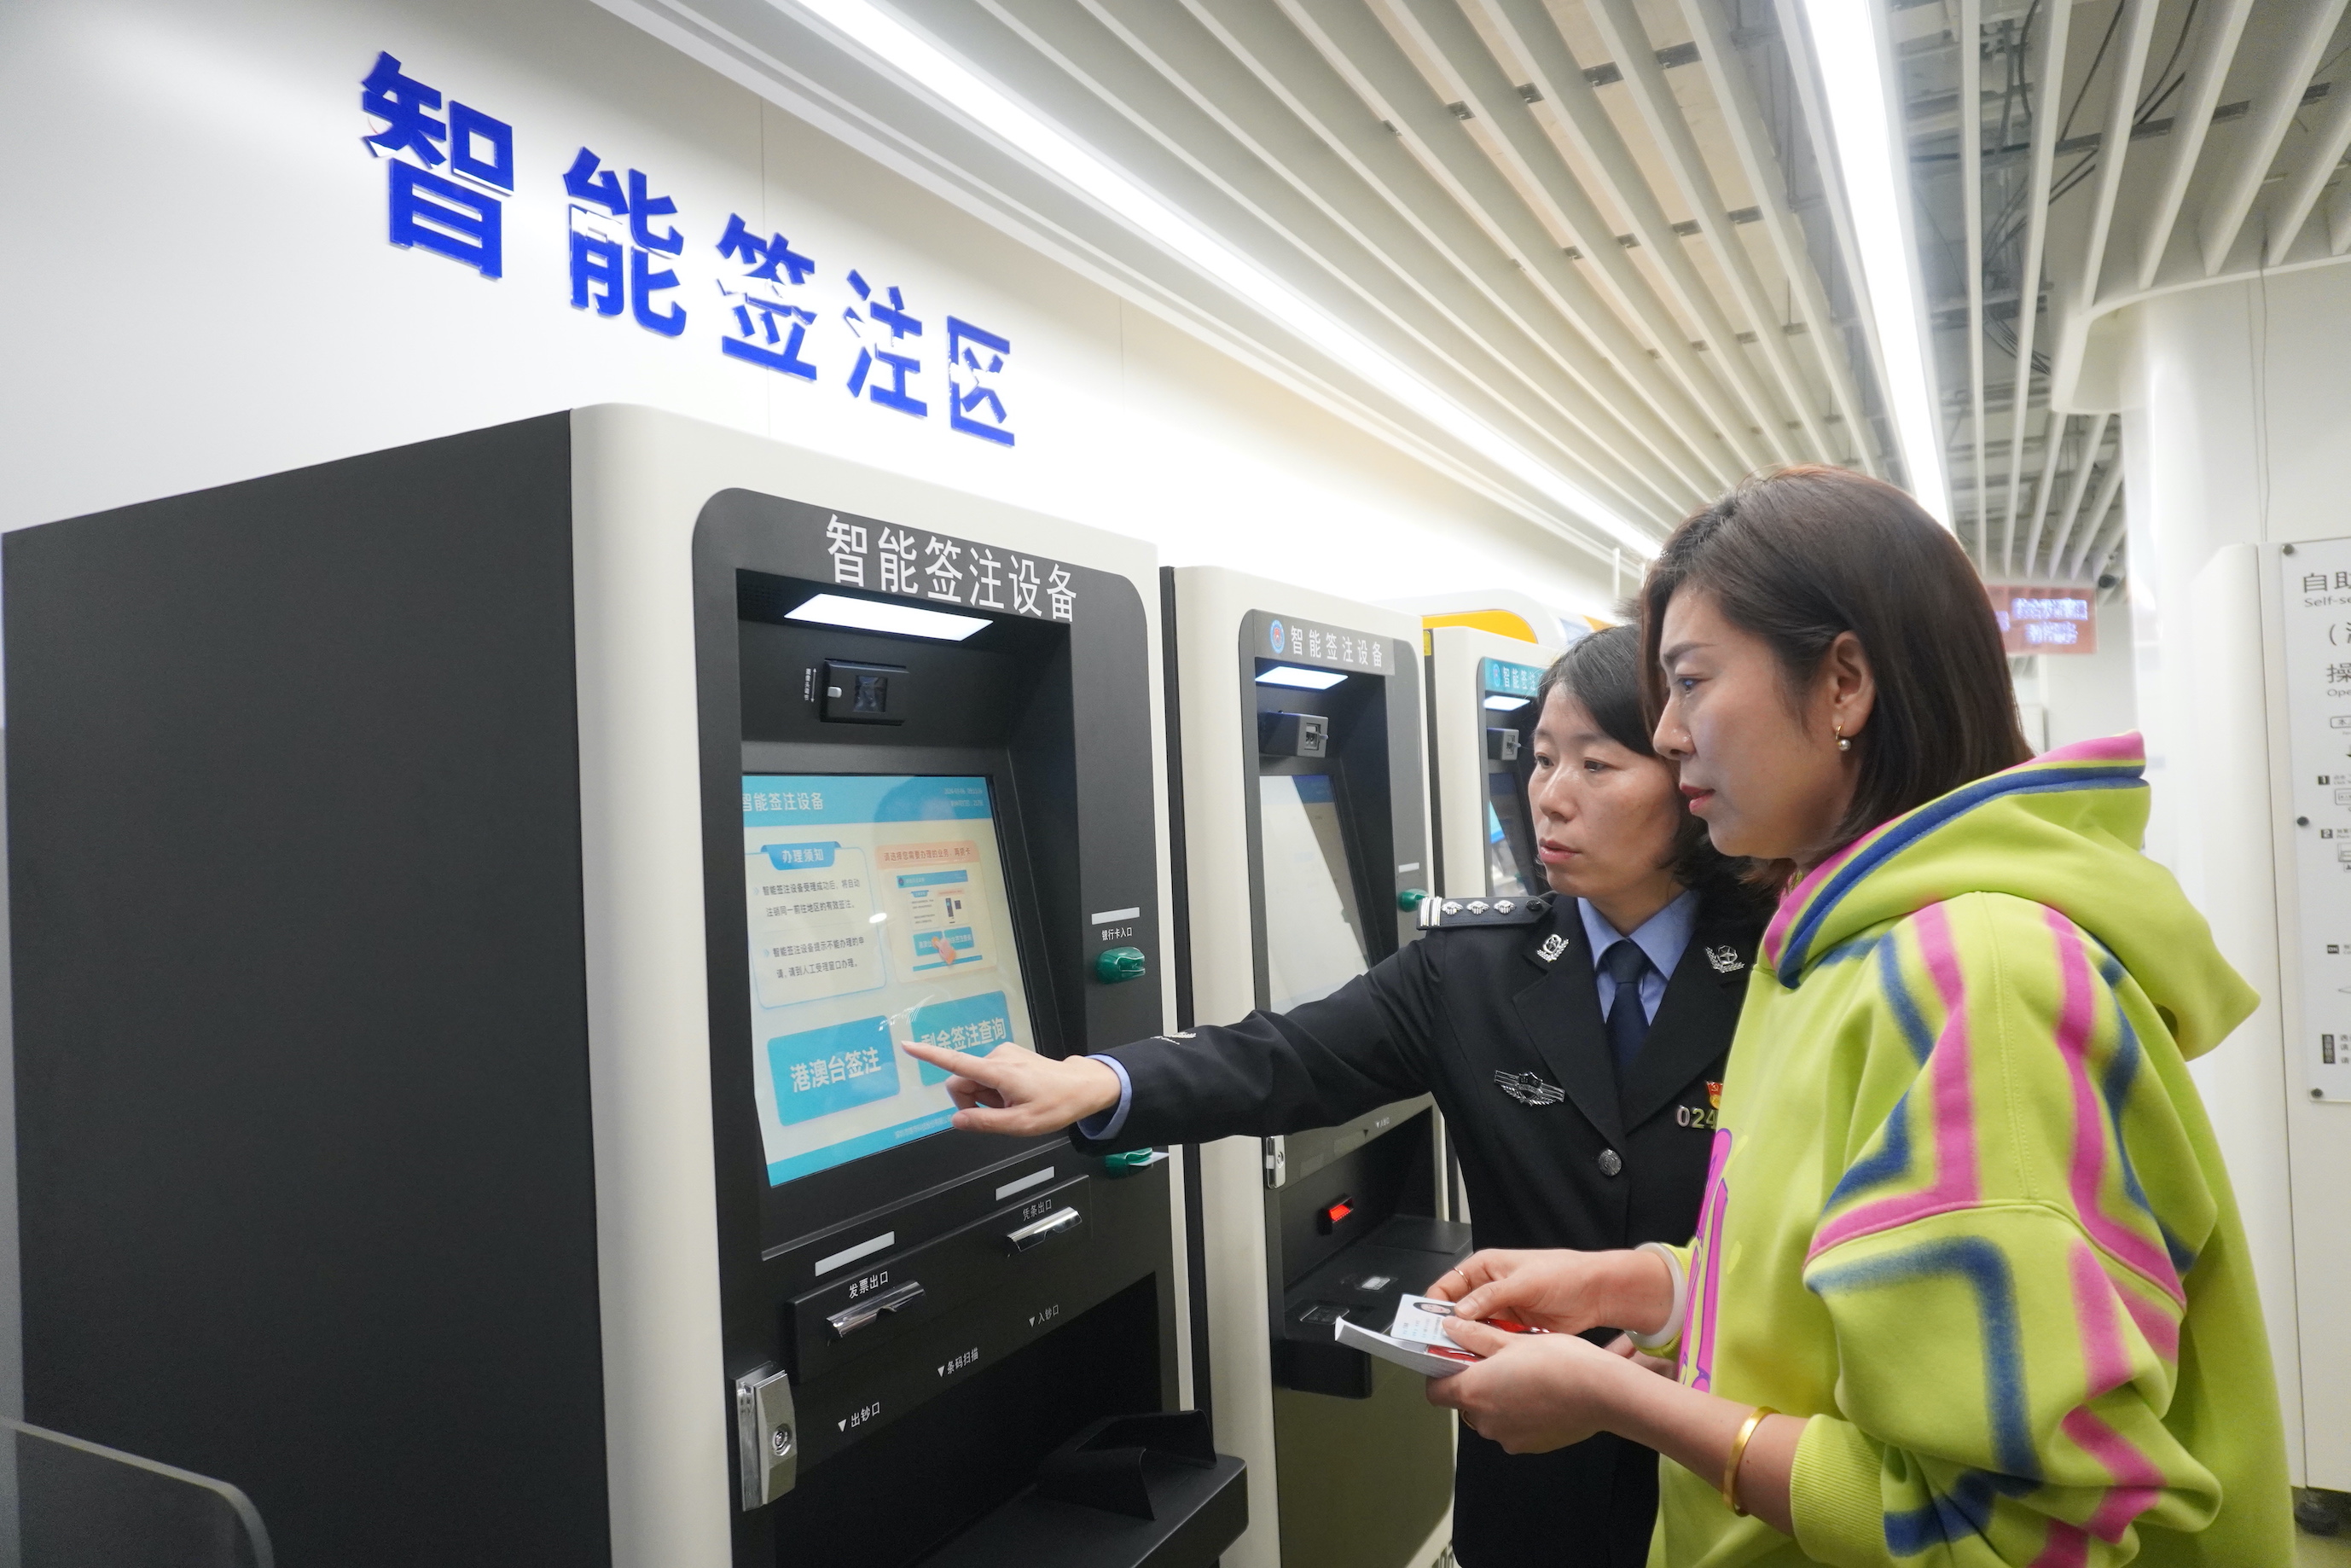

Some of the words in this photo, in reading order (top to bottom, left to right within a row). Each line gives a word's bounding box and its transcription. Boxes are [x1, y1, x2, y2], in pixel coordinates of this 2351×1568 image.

[362, 50, 1015, 447] 智能签注区
[826, 514, 1077, 622] 智能签注设备
[1291, 625, 1382, 667] 智能签注设备
[781, 848, 824, 863] 办理须知
[1101, 926, 1133, 941] 银行卡入口
[790, 1046, 882, 1093] 港澳台签注
[1023, 1199, 1052, 1222] 凭条出口
[849, 1270, 888, 1299] 发票出口
[1037, 1304, 1059, 1325] 入钞口
[947, 1346, 979, 1374] 条码扫描
[851, 1402, 879, 1428] 出钞口
